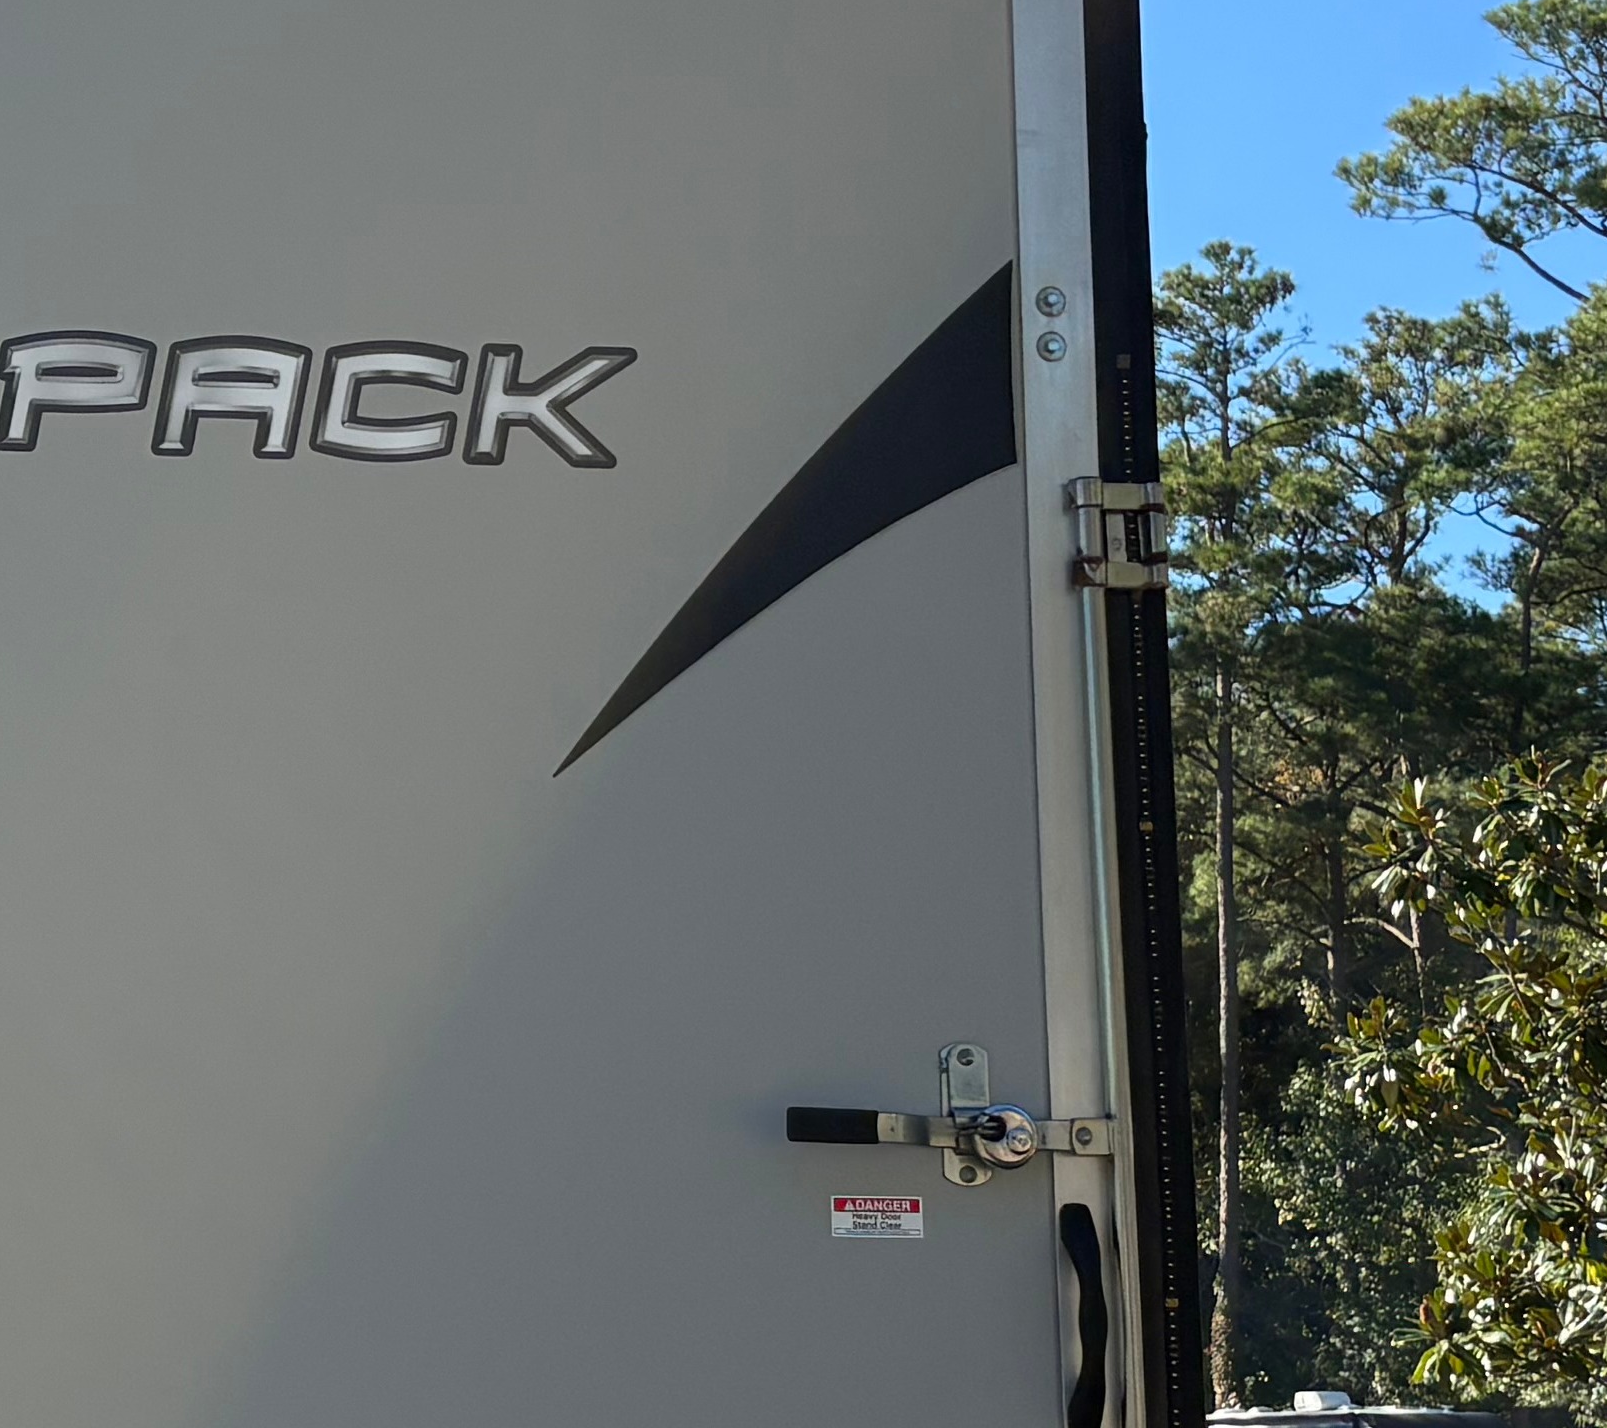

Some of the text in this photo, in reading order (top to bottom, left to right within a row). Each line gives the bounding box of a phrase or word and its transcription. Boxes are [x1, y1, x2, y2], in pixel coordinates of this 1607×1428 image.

[855, 1200, 911, 1212] DANGER
[852, 1220, 902, 1230] Stand Clear
